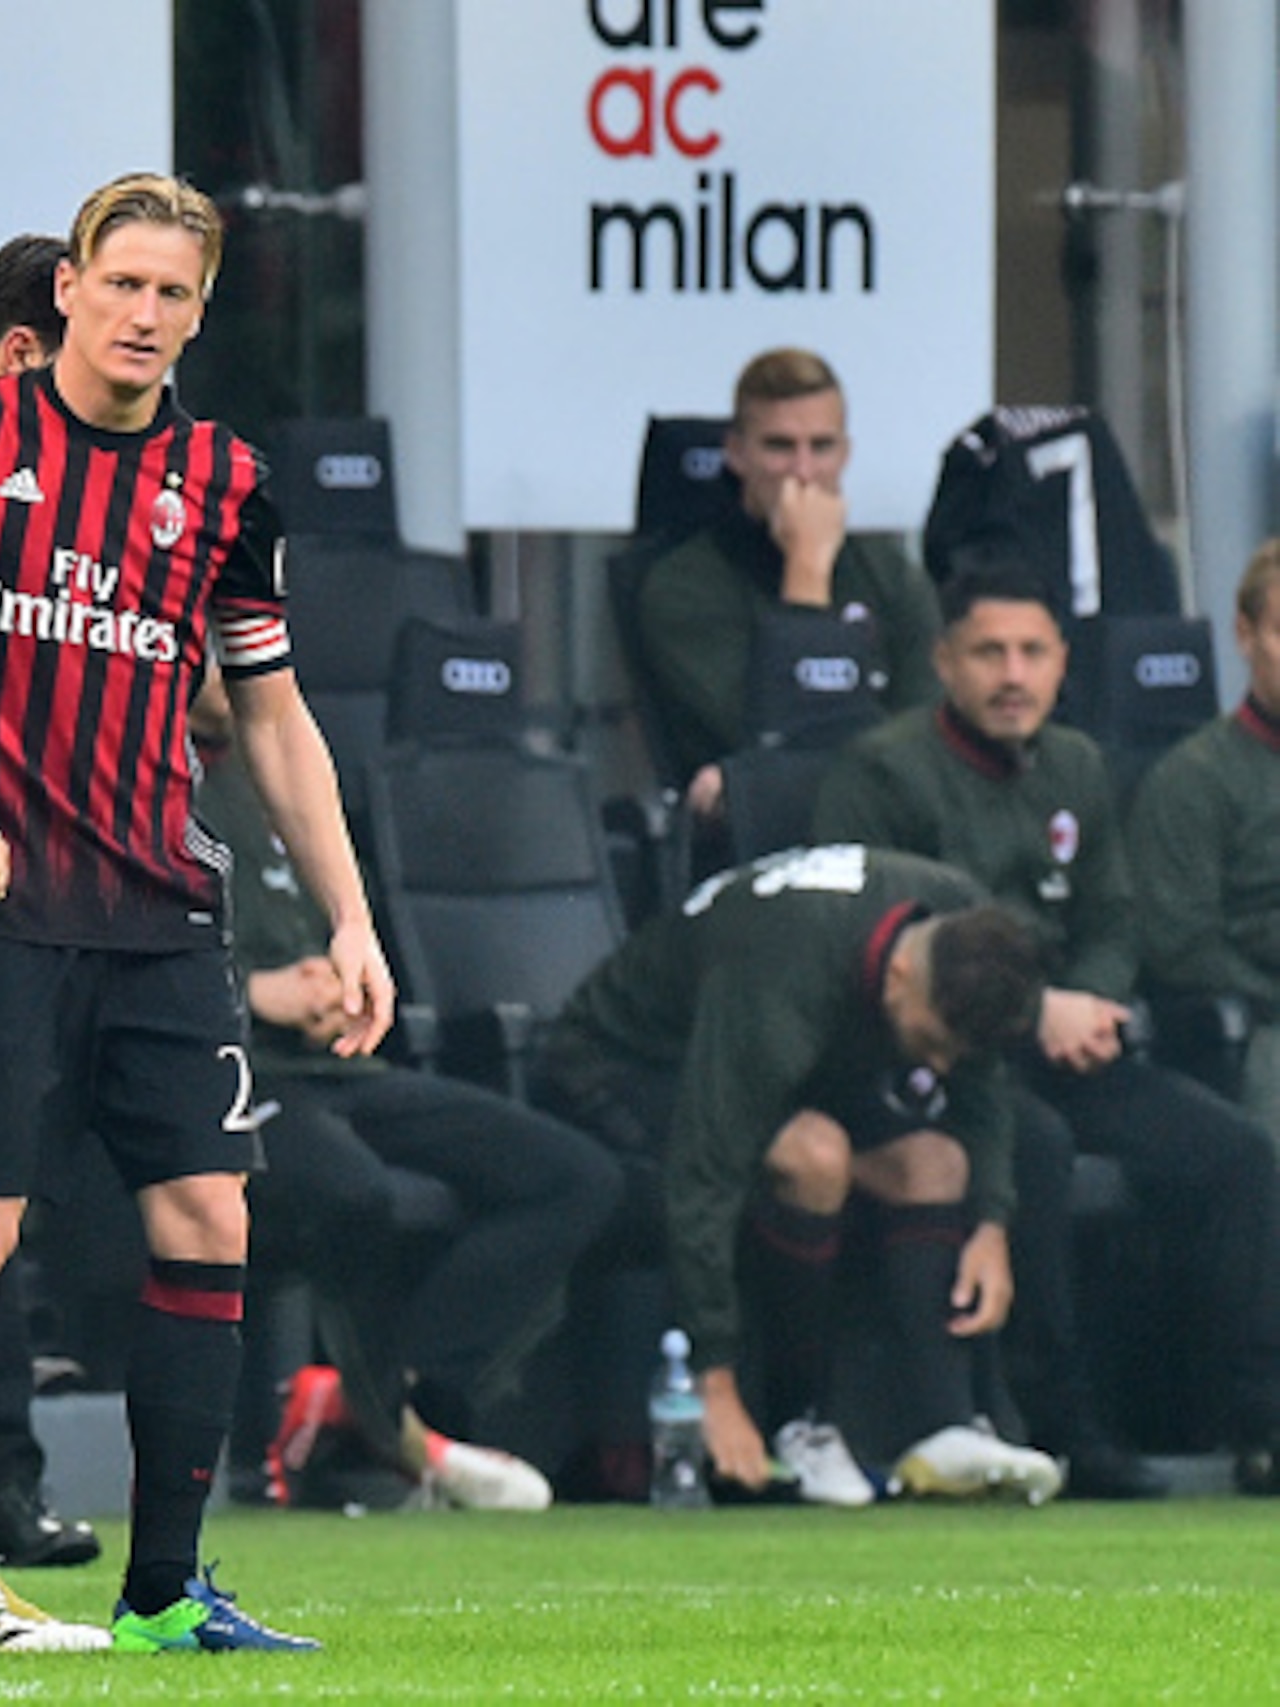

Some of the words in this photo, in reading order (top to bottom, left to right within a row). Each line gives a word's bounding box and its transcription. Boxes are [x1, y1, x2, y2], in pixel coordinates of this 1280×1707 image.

[587, 65, 723, 159] ac
[589, 171, 876, 295] milan
[54, 547, 119, 601] Fly
[1026, 432, 1101, 617] 7
